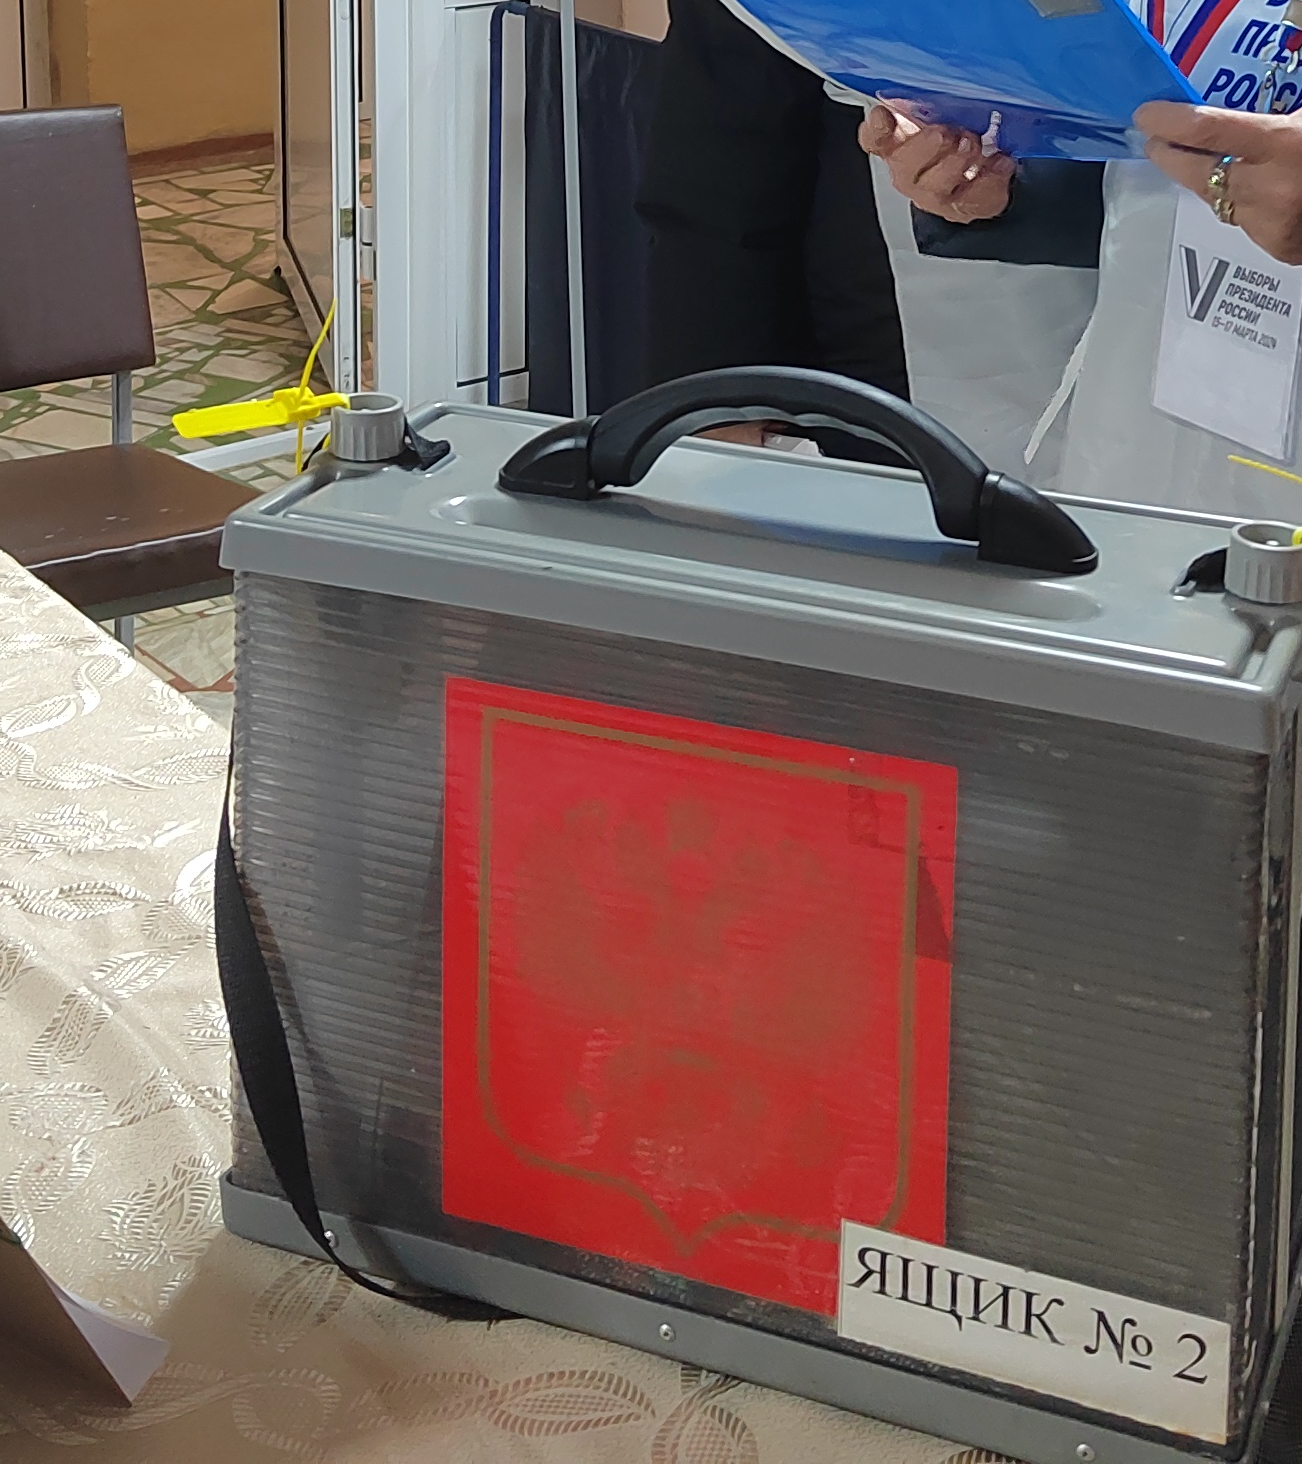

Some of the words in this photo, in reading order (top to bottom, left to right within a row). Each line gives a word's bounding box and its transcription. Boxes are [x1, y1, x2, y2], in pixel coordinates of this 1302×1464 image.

[1232, 265, 1281, 293] ВЫБОРЫ
[1217, 299, 1262, 326] РОССИИ
[1224, 283, 1292, 318] ПРЕЗИДЕНТА
[1232, 323, 1260, 344] МАРТА
[846, 1245, 1066, 1347] ЯЩИК
[1083, 1306, 1154, 1372] №
[1172, 1332, 1209, 1385] 2
